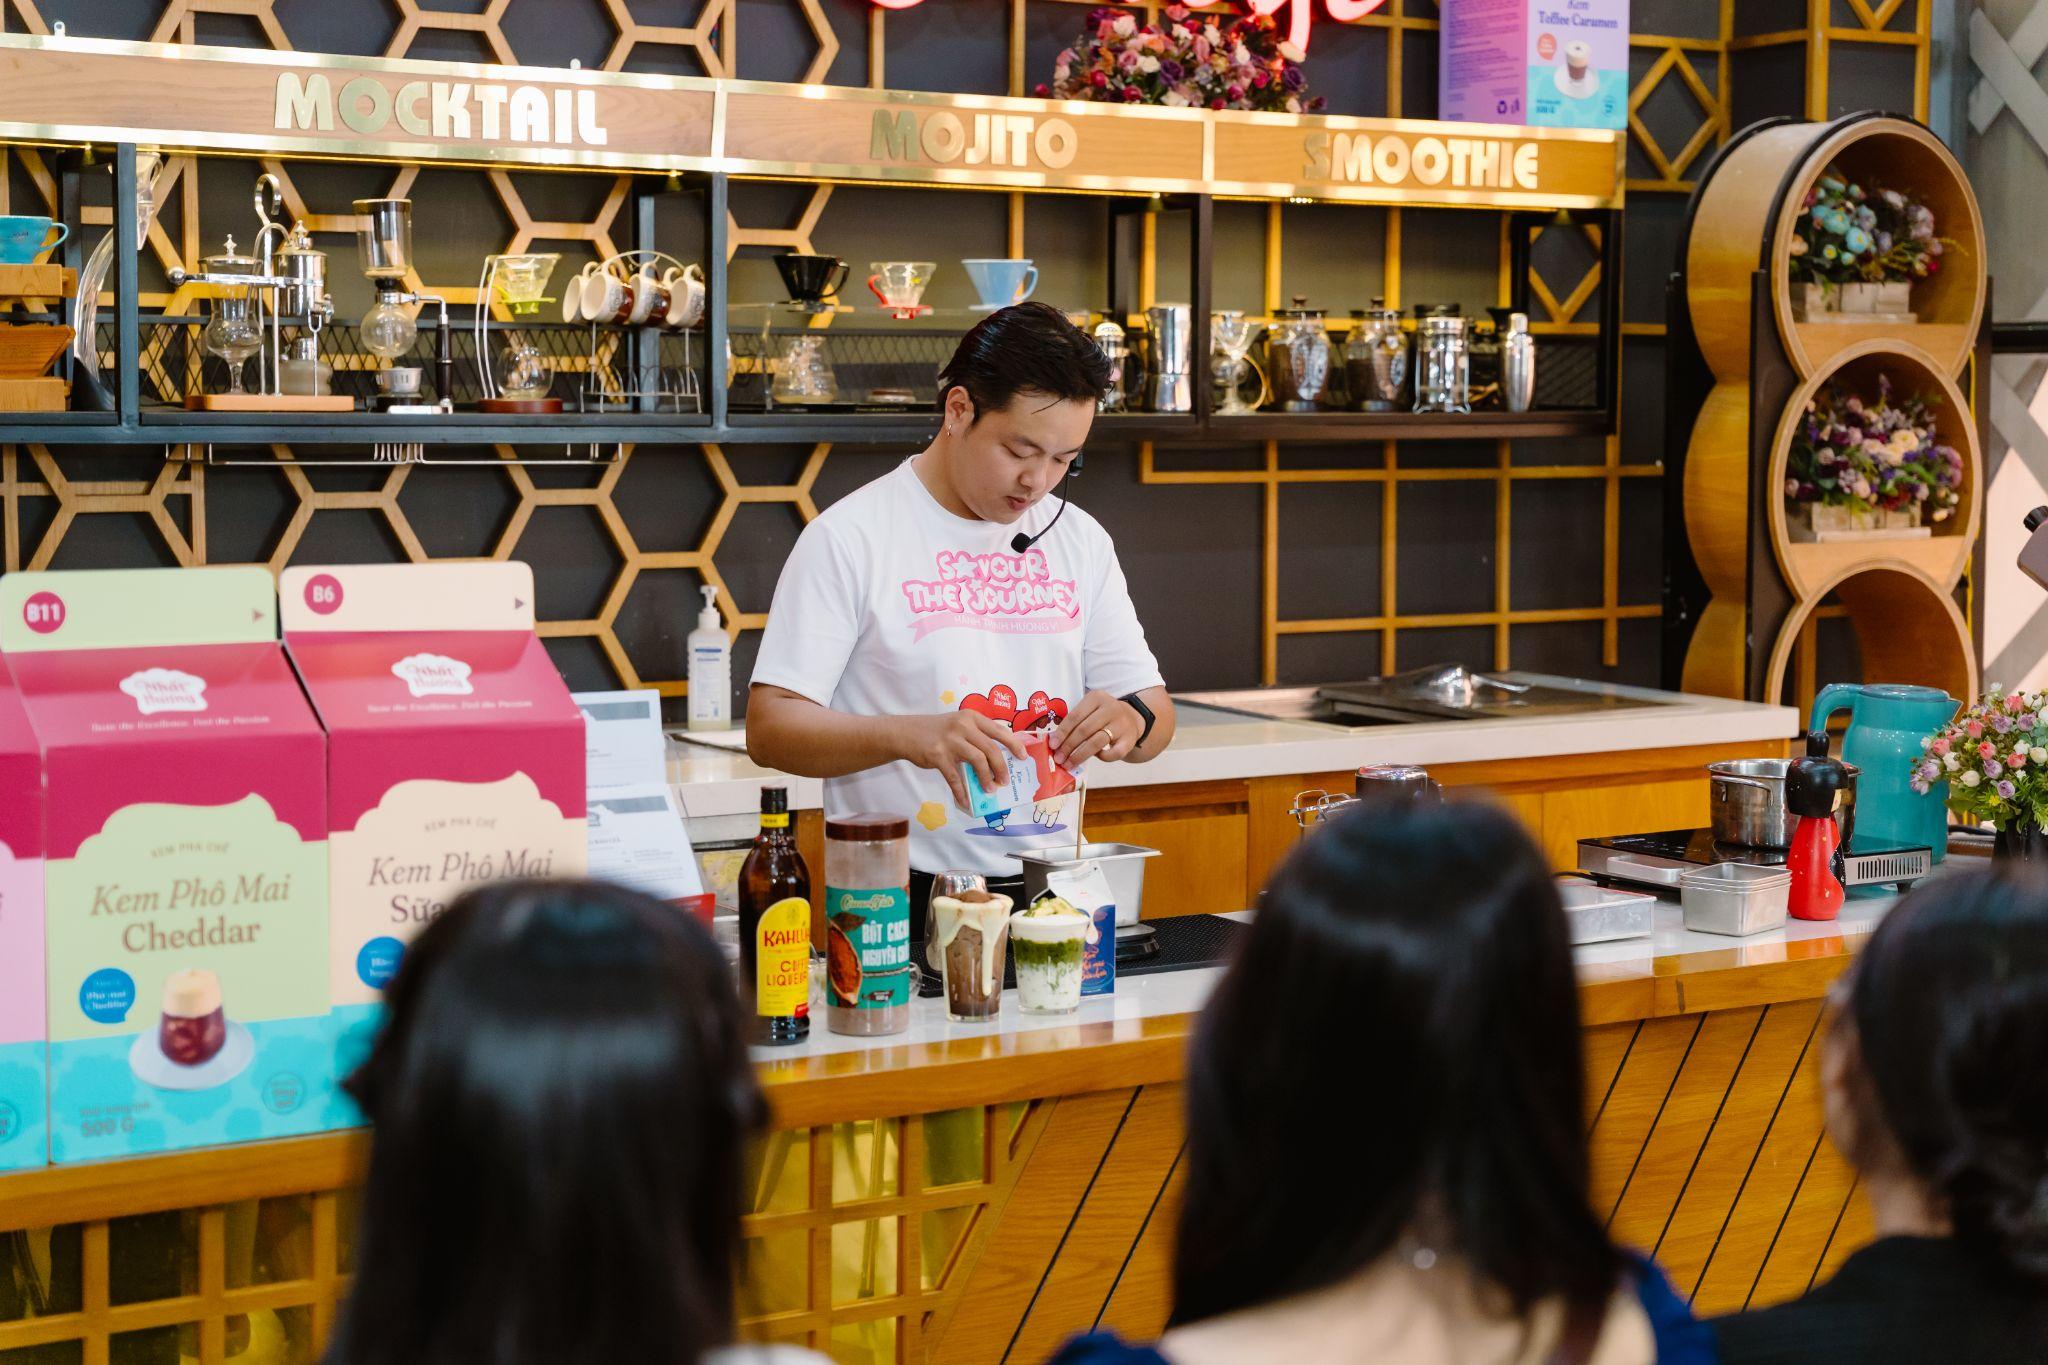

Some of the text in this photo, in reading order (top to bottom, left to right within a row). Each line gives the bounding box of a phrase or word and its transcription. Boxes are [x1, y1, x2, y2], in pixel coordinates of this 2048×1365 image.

[275, 72, 607, 145] MOCKTAIL
[870, 108, 1078, 169] MOJITO
[1303, 132, 1538, 189] SMOOTHIE
[26, 602, 61, 623] B11
[312, 585, 335, 603] B6
[905, 580, 1080, 616] THE JOURNEY
[368, 856, 432, 887] Kem
[439, 851, 493, 882] Phô
[499, 848, 555, 880] Mai
[90, 873, 294, 917] Kem Phô Mai
[391, 894, 446, 924] Sữa
[122, 915, 261, 953] Cheddar
[862, 920, 883, 945] BỘT
